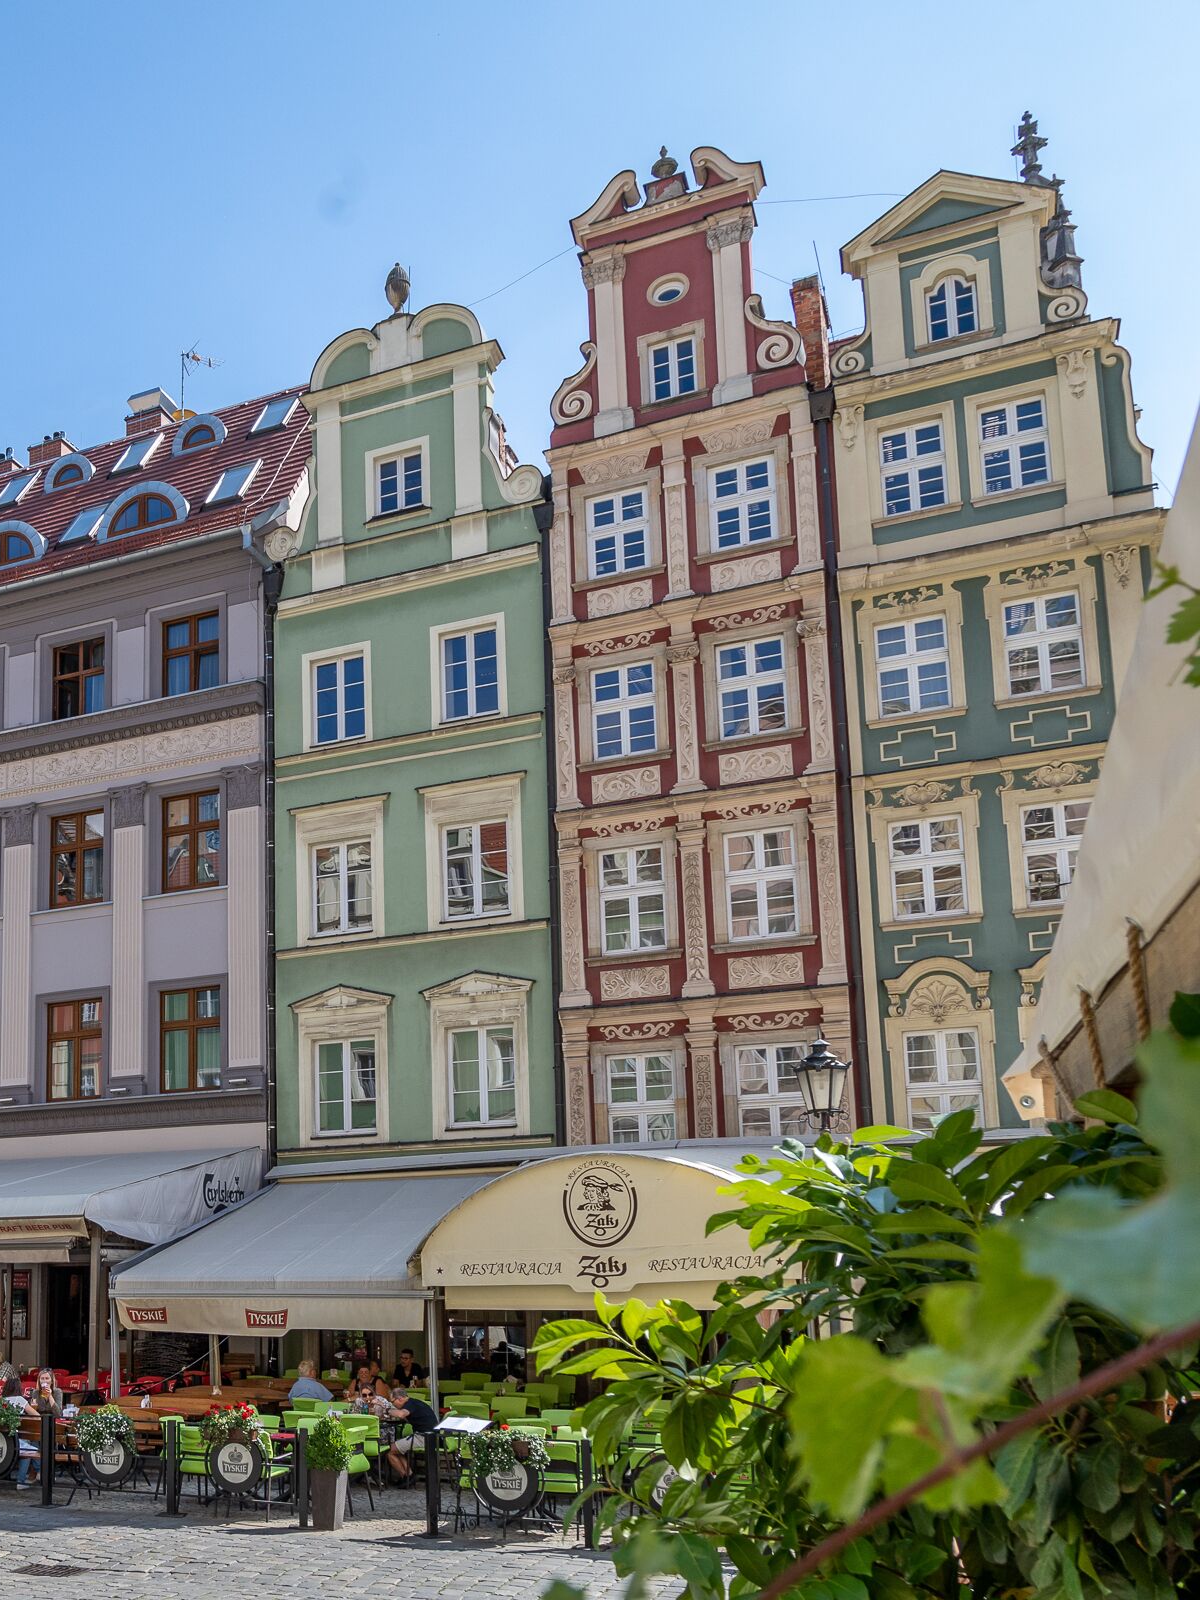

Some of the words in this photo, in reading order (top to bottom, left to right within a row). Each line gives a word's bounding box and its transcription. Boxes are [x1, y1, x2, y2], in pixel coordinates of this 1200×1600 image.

[568, 1160, 630, 1180] RESTAURACJA
[26, 1224, 50, 1232] BEER
[52, 1223, 72, 1231] PUB
[459, 1261, 563, 1276] RESTAURACJA
[648, 1255, 763, 1273] RESTAURACJA
[129, 1310, 164, 1321] TYSKIE
[248, 1313, 284, 1325] TYSKIE
[96, 1456, 119, 1465] TYSKIE
[224, 1463, 247, 1473] TYSKIE
[492, 1478, 520, 1489] TYSKIE
